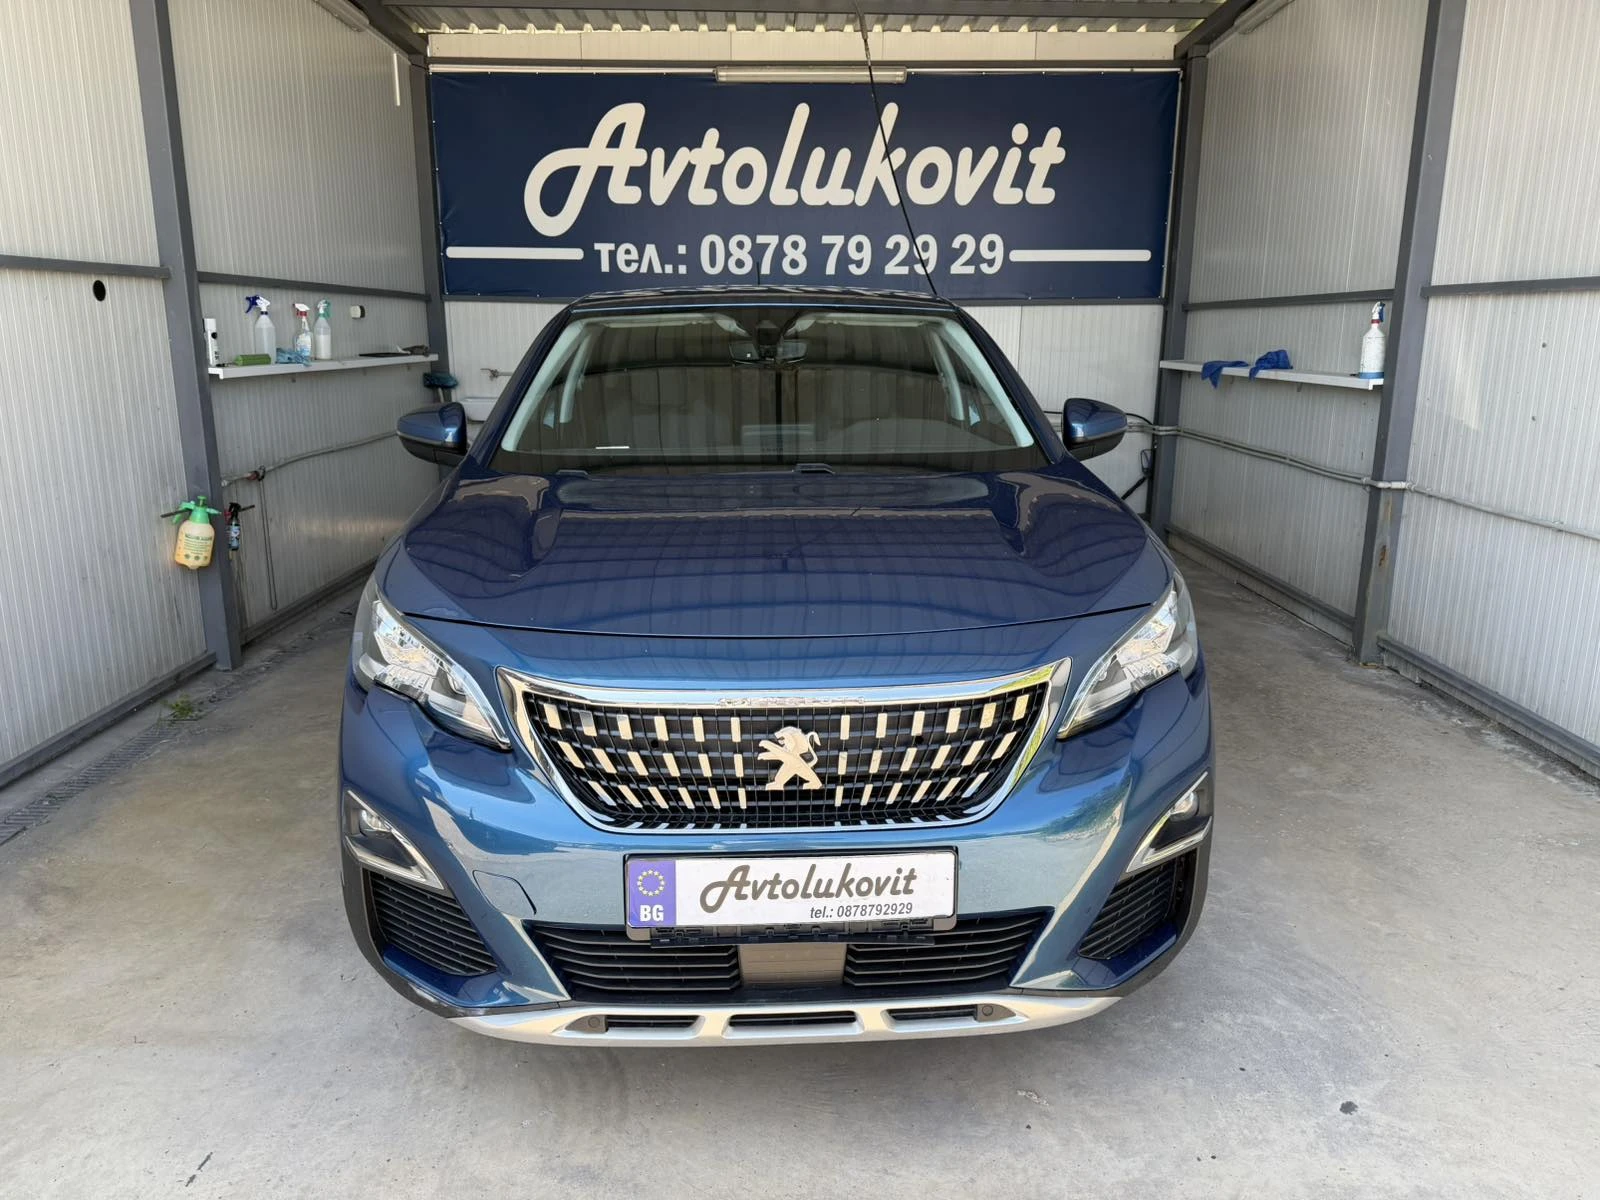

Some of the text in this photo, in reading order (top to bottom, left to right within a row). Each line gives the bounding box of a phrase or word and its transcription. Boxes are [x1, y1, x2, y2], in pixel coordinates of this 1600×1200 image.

[523, 102, 1066, 237] Avtolukovit
[593, 233, 1005, 276] тел.: 0878 79 29 29
[700, 863, 918, 914] Avtolukovit
[639, 904, 665, 922] BG
[810, 902, 913, 920] tel.: 0878792929
